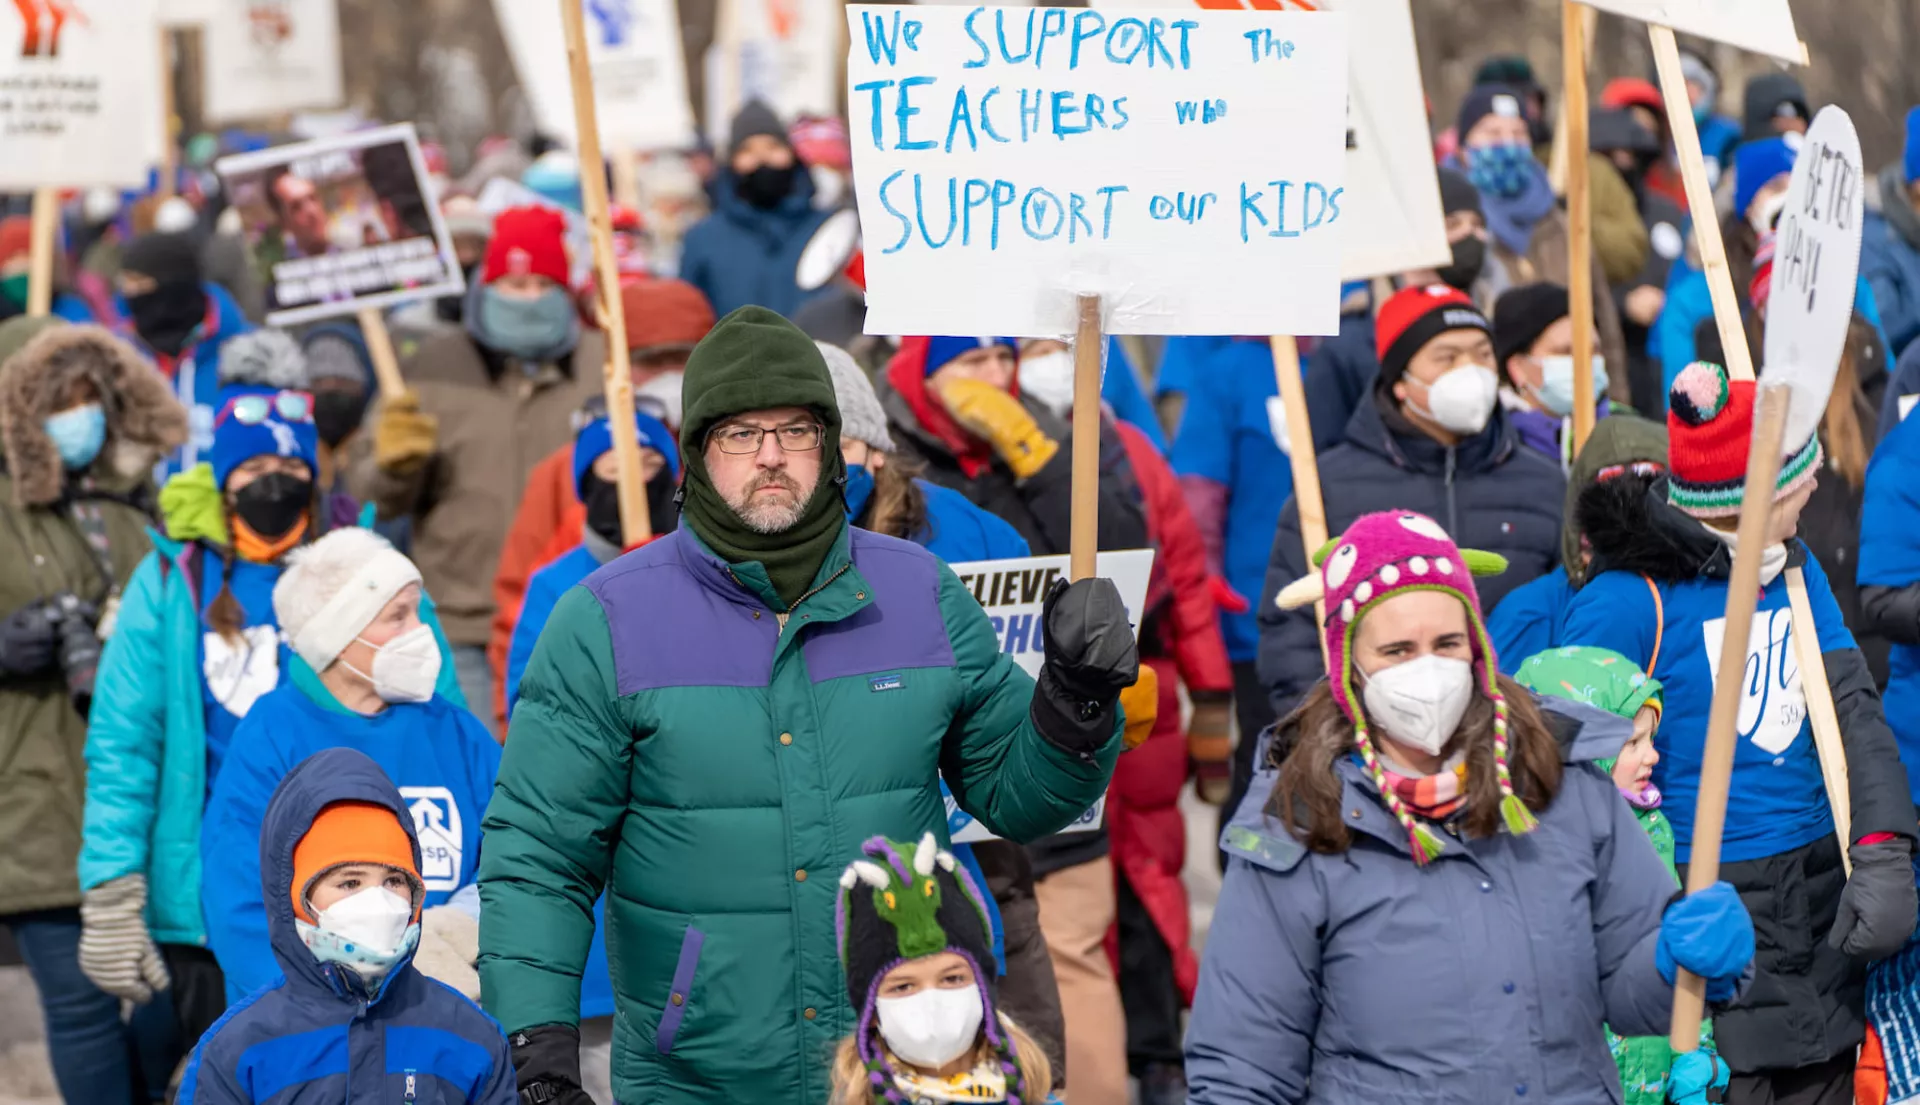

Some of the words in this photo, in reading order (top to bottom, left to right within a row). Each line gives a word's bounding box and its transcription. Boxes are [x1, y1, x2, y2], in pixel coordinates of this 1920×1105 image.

[862, 10, 923, 66] We
[963, 7, 1199, 70] SUPPORT
[1243, 28, 1295, 63] The
[854, 76, 1129, 153] TEACHERS
[879, 170, 1129, 254] SUPPORT
[1149, 192, 1217, 224] our
[1240, 180, 1344, 243] KIDS
